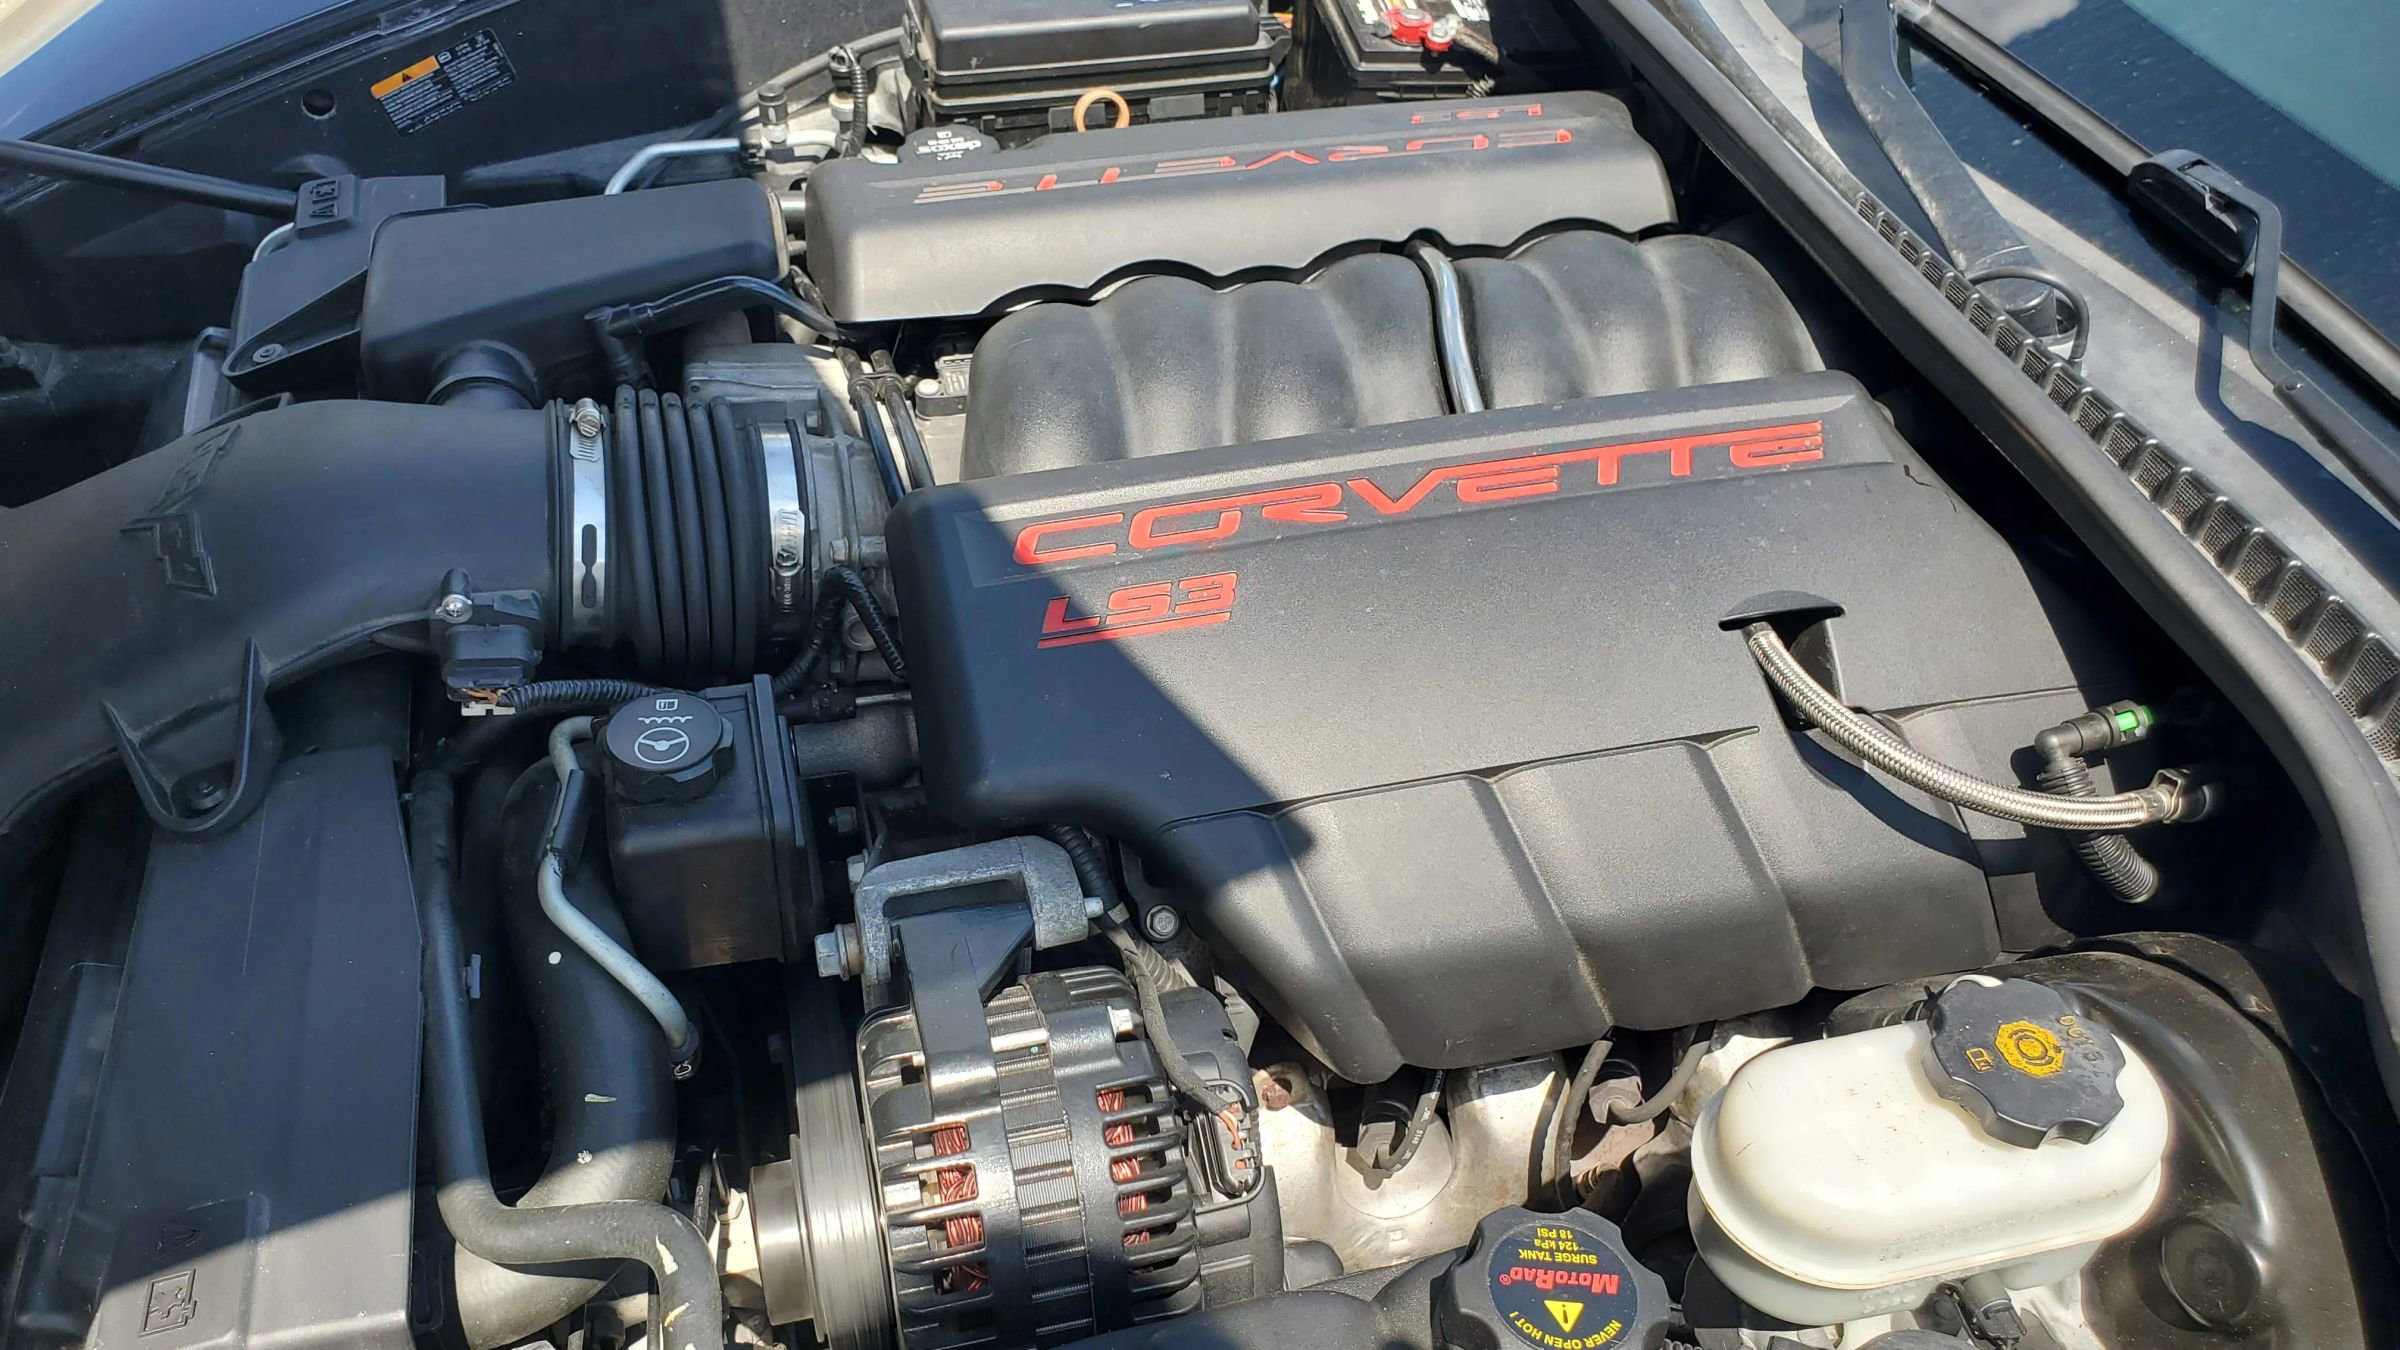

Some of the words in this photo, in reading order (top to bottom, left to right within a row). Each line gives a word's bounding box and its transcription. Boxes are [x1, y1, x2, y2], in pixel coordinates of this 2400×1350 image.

[1012, 420, 1825, 565] CORVETTE
[1041, 570, 1239, 636] LS3
[1537, 1227, 1558, 1239] PSI
[1559, 1230, 1573, 1239] 18
[1533, 1238, 1557, 1250] kPa
[1559, 1240, 1580, 1252] 124
[1518, 1248, 1553, 1262] TANK
[1554, 1251, 1598, 1265] SURGE
[1515, 1318, 1544, 1340] HOT
[1582, 1320, 1622, 1348] NEVER
[1543, 1335, 1583, 1350] OPEN
